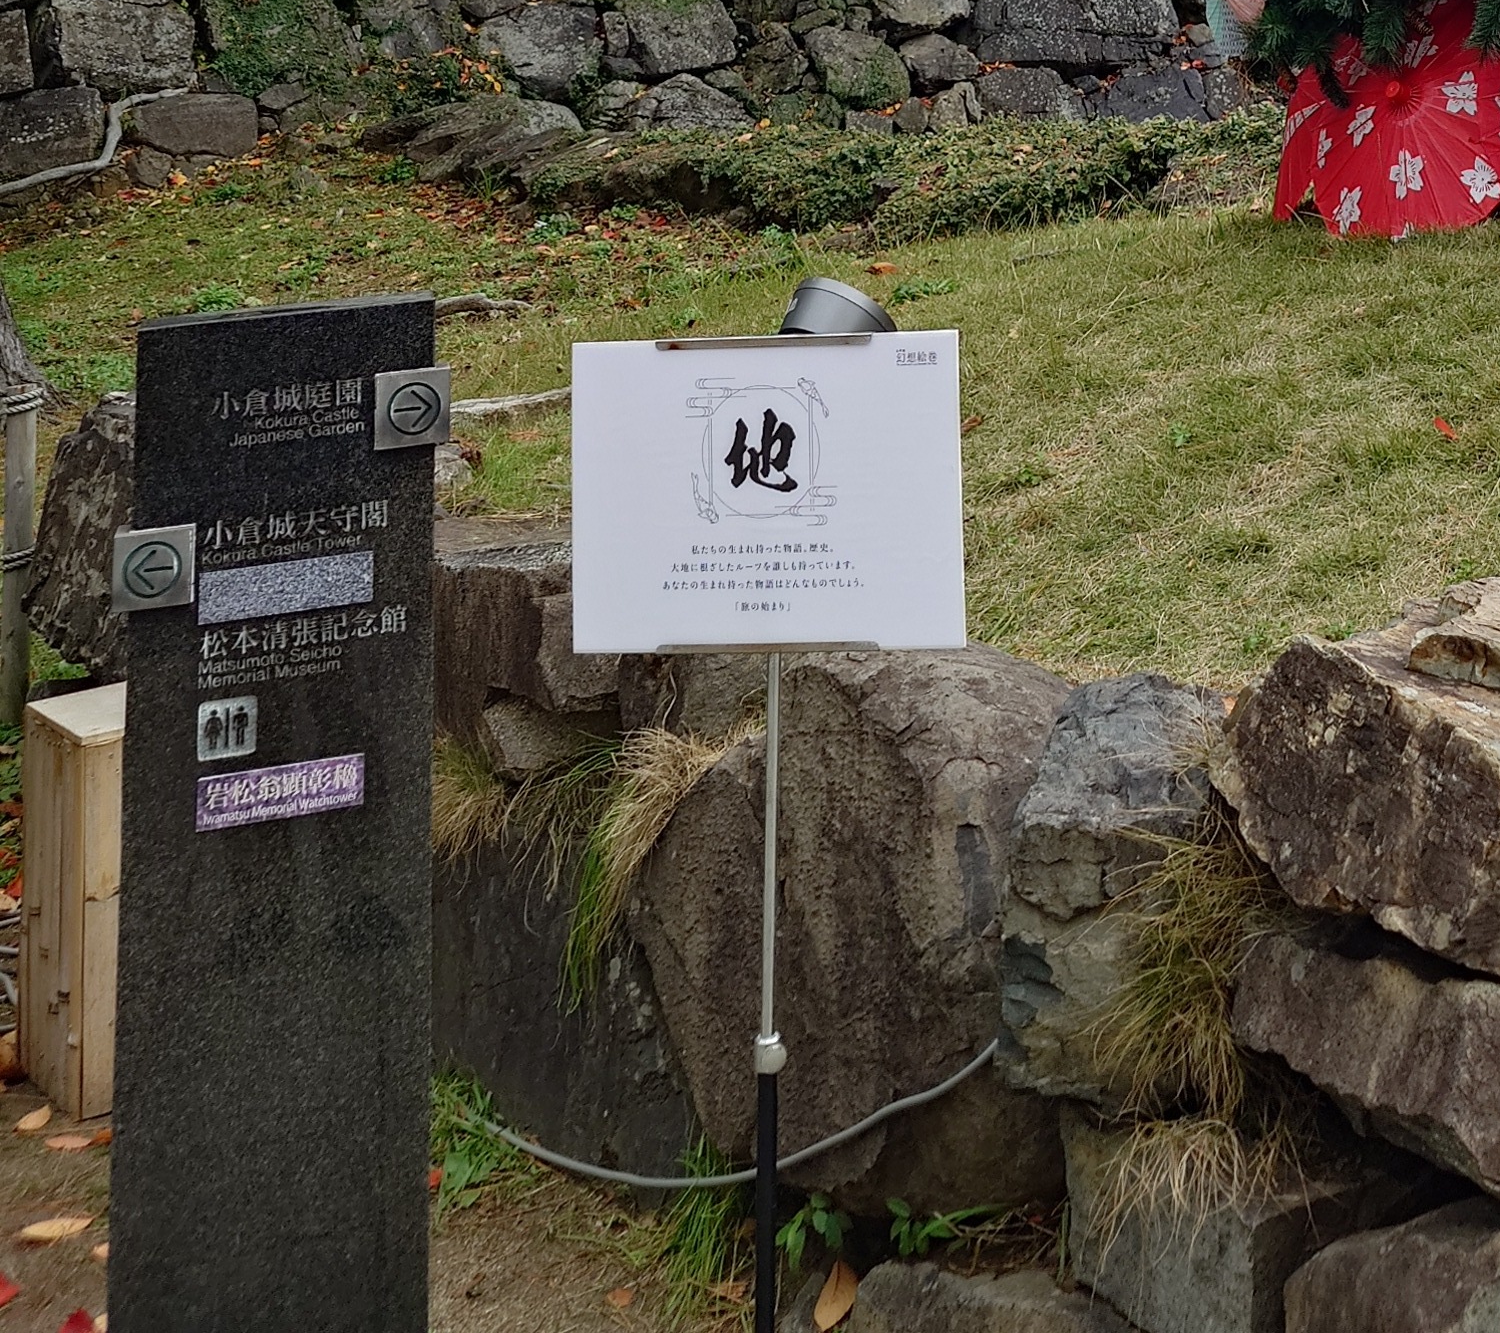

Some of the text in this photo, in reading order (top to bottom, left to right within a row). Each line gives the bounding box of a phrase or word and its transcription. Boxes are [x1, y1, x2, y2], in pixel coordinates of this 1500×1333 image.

[211, 377, 362, 420] 小倉城庭園
[255, 406, 360, 429] Kokura Castle
[229, 421, 365, 448] Japanese Garden
[724, 408, 798, 493] 地
[203, 499, 389, 550] 小倉城天守閣
[202, 535, 362, 565] Kokura Castle Tower
[199, 604, 407, 660] 松本清張記念館
[197, 644, 343, 675] Matsumoto Seicho
[197, 659, 342, 689] Memorial Museum
[203, 791, 359, 825] Iwamatsu Memorial Watchtower
